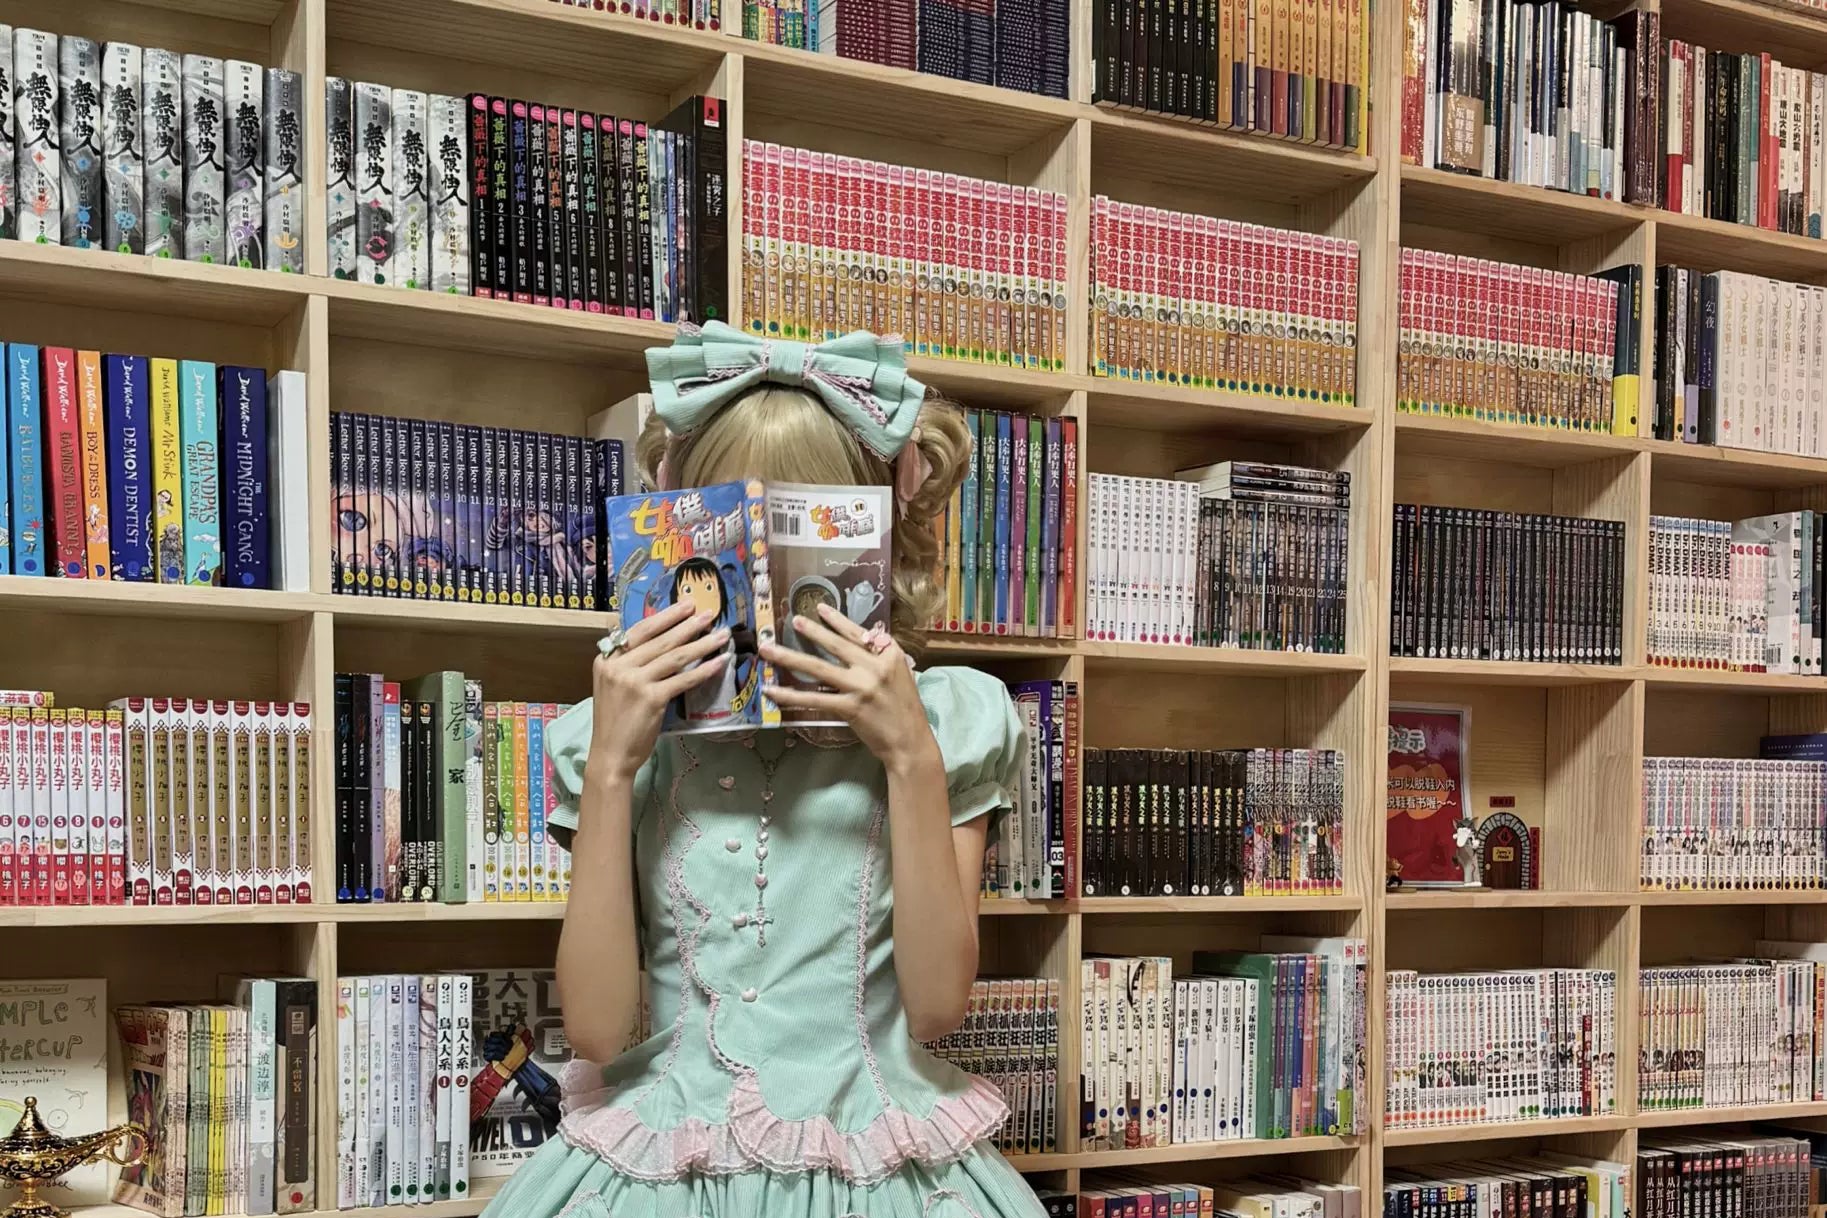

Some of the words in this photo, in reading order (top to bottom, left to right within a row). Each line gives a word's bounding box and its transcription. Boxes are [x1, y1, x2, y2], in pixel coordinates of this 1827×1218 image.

[24, 73, 60, 150] 無限住人
[68, 79, 101, 156] 無限住人
[108, 85, 143, 161] 無限住人
[147, 91, 181, 166] 無限住人
[190, 97, 224, 172] 無限住人
[229, 102, 263, 177] 無限住人
[473, 113, 487, 197] 薔薇下的真相
[493, 117, 506, 200] 薔薇下的真相
[513, 120, 526, 202] 薔薇下的真相
[531, 123, 544, 205] 薔薇下的真相
[548, 126, 562, 208] 薔薇下的真相
[565, 129, 578, 210] 薔薇下的真相
[1705, 300, 1715, 329] 幻夜
[86, 431, 98, 454] BOY
[123, 427, 138, 481] DEMON
[162, 430, 175, 449] Mr
[186, 444, 198, 477] GREAT
[986, 438, 995, 482] 大奉打更人
[1001, 438, 1010, 483] 大奉打更人
[1017, 438, 1027, 484] 大奉打更人
[87, 462, 100, 499] DRESS
[162, 450, 177, 480] Stink
[196, 441, 216, 525] GRANDPA'S
[1032, 442, 1041, 486] 大奉打更人
[1051, 442, 1060, 487] 大奉打更人
[1067, 442, 1075, 488] 大奉打更人
[124, 485, 139, 546] DENTIST
[188, 479, 199, 520] ESCAPE
[444, 493, 450, 501] 9
[457, 495, 466, 503] 10
[485, 497, 494, 505] 12
[512, 499, 522, 508] 14
[554, 503, 564, 512] 17
[584, 506, 594, 514] 19
[238, 519, 254, 563] GANG
[17, 730, 28, 790] 櫻桃小丸子
[35, 731, 47, 791] 櫻桃小丸子
[53, 731, 65, 791] 櫻桃小丸子
[71, 731, 84, 791] 櫻桃小丸子
[91, 732, 103, 791] 櫻桃小丸子
[109, 732, 122, 791] 櫻桃小丸子
[1388, 728, 1425, 752] 提示
[449, 768, 465, 785] 家
[408, 842, 417, 889] OVERLORD
[428, 841, 436, 888] OVERLORD
[1052, 851, 1063, 860] 03
[496, 973, 527, 997] 大
[438, 1017, 452, 1070] 鳥人大系
[457, 1017, 469, 1069] 鳥人大系
[257, 1053, 270, 1101] 渡边淳一
